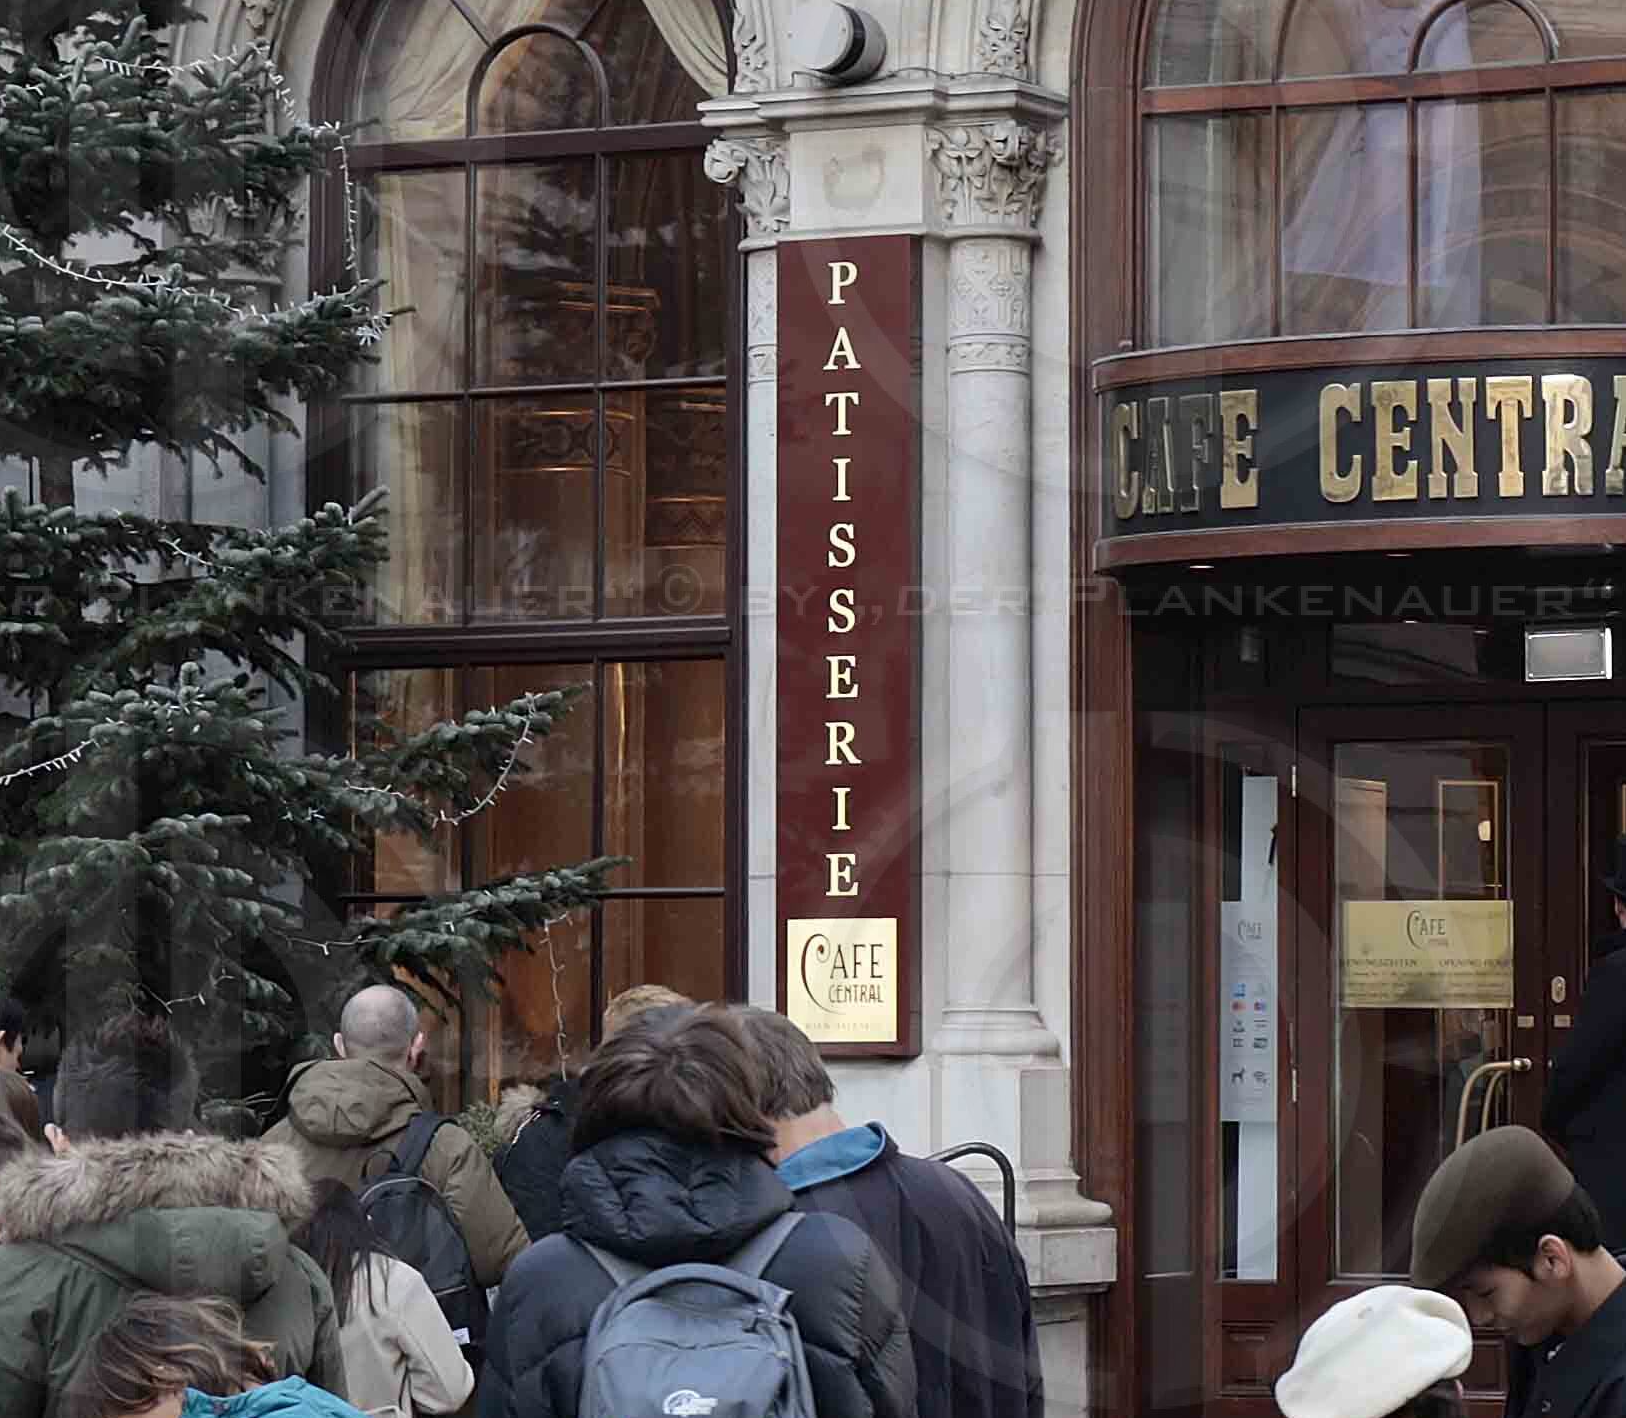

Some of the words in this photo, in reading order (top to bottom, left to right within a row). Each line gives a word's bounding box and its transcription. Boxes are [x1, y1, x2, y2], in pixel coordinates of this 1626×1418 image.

[1112, 389, 1259, 519] CAFE
[822, 261, 862, 897] PATISSERIE
[1407, 910, 1446, 949] CAFE
[801, 934, 884, 1015] CAFE
[829, 984, 884, 1003] CENTRAL
